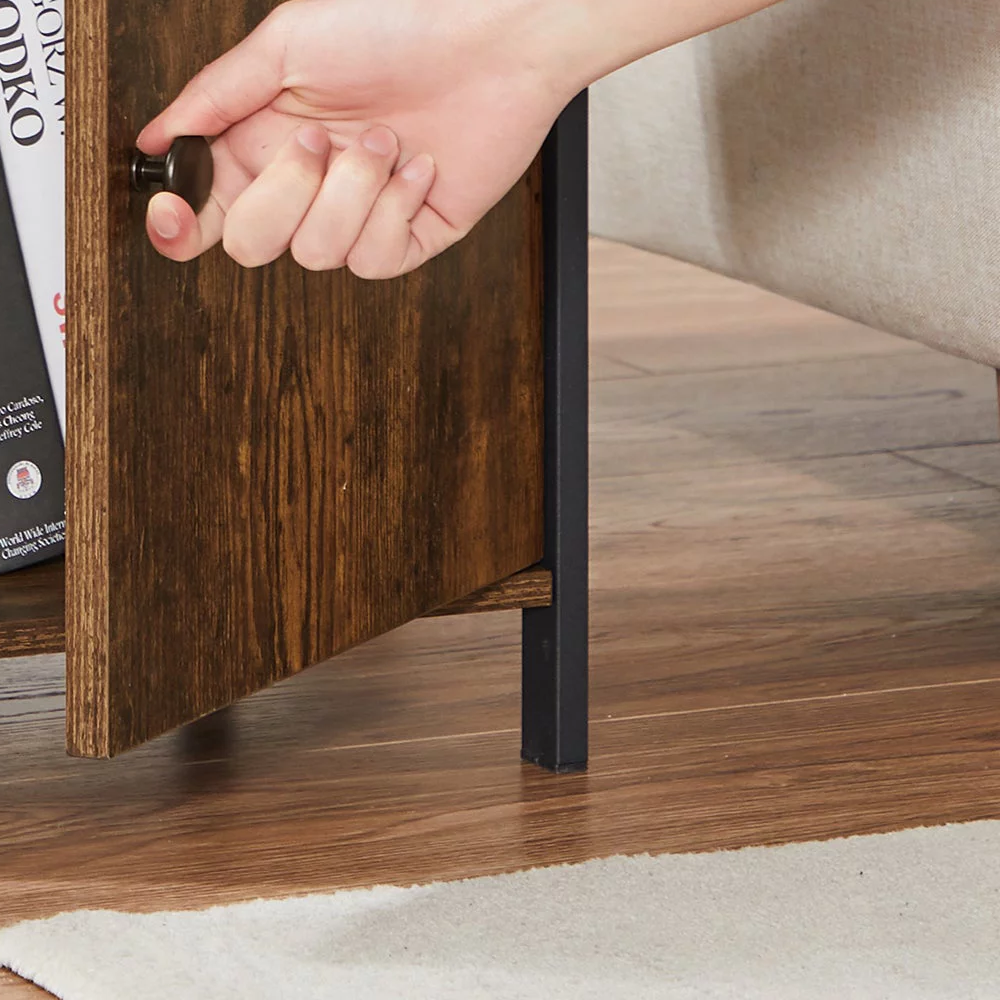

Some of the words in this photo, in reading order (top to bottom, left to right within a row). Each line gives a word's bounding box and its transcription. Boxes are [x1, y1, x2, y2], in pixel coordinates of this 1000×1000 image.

[23, 420, 42, 433] Cole
[23, 526, 44, 540] Wide
[44, 520, 66, 534] Intern
